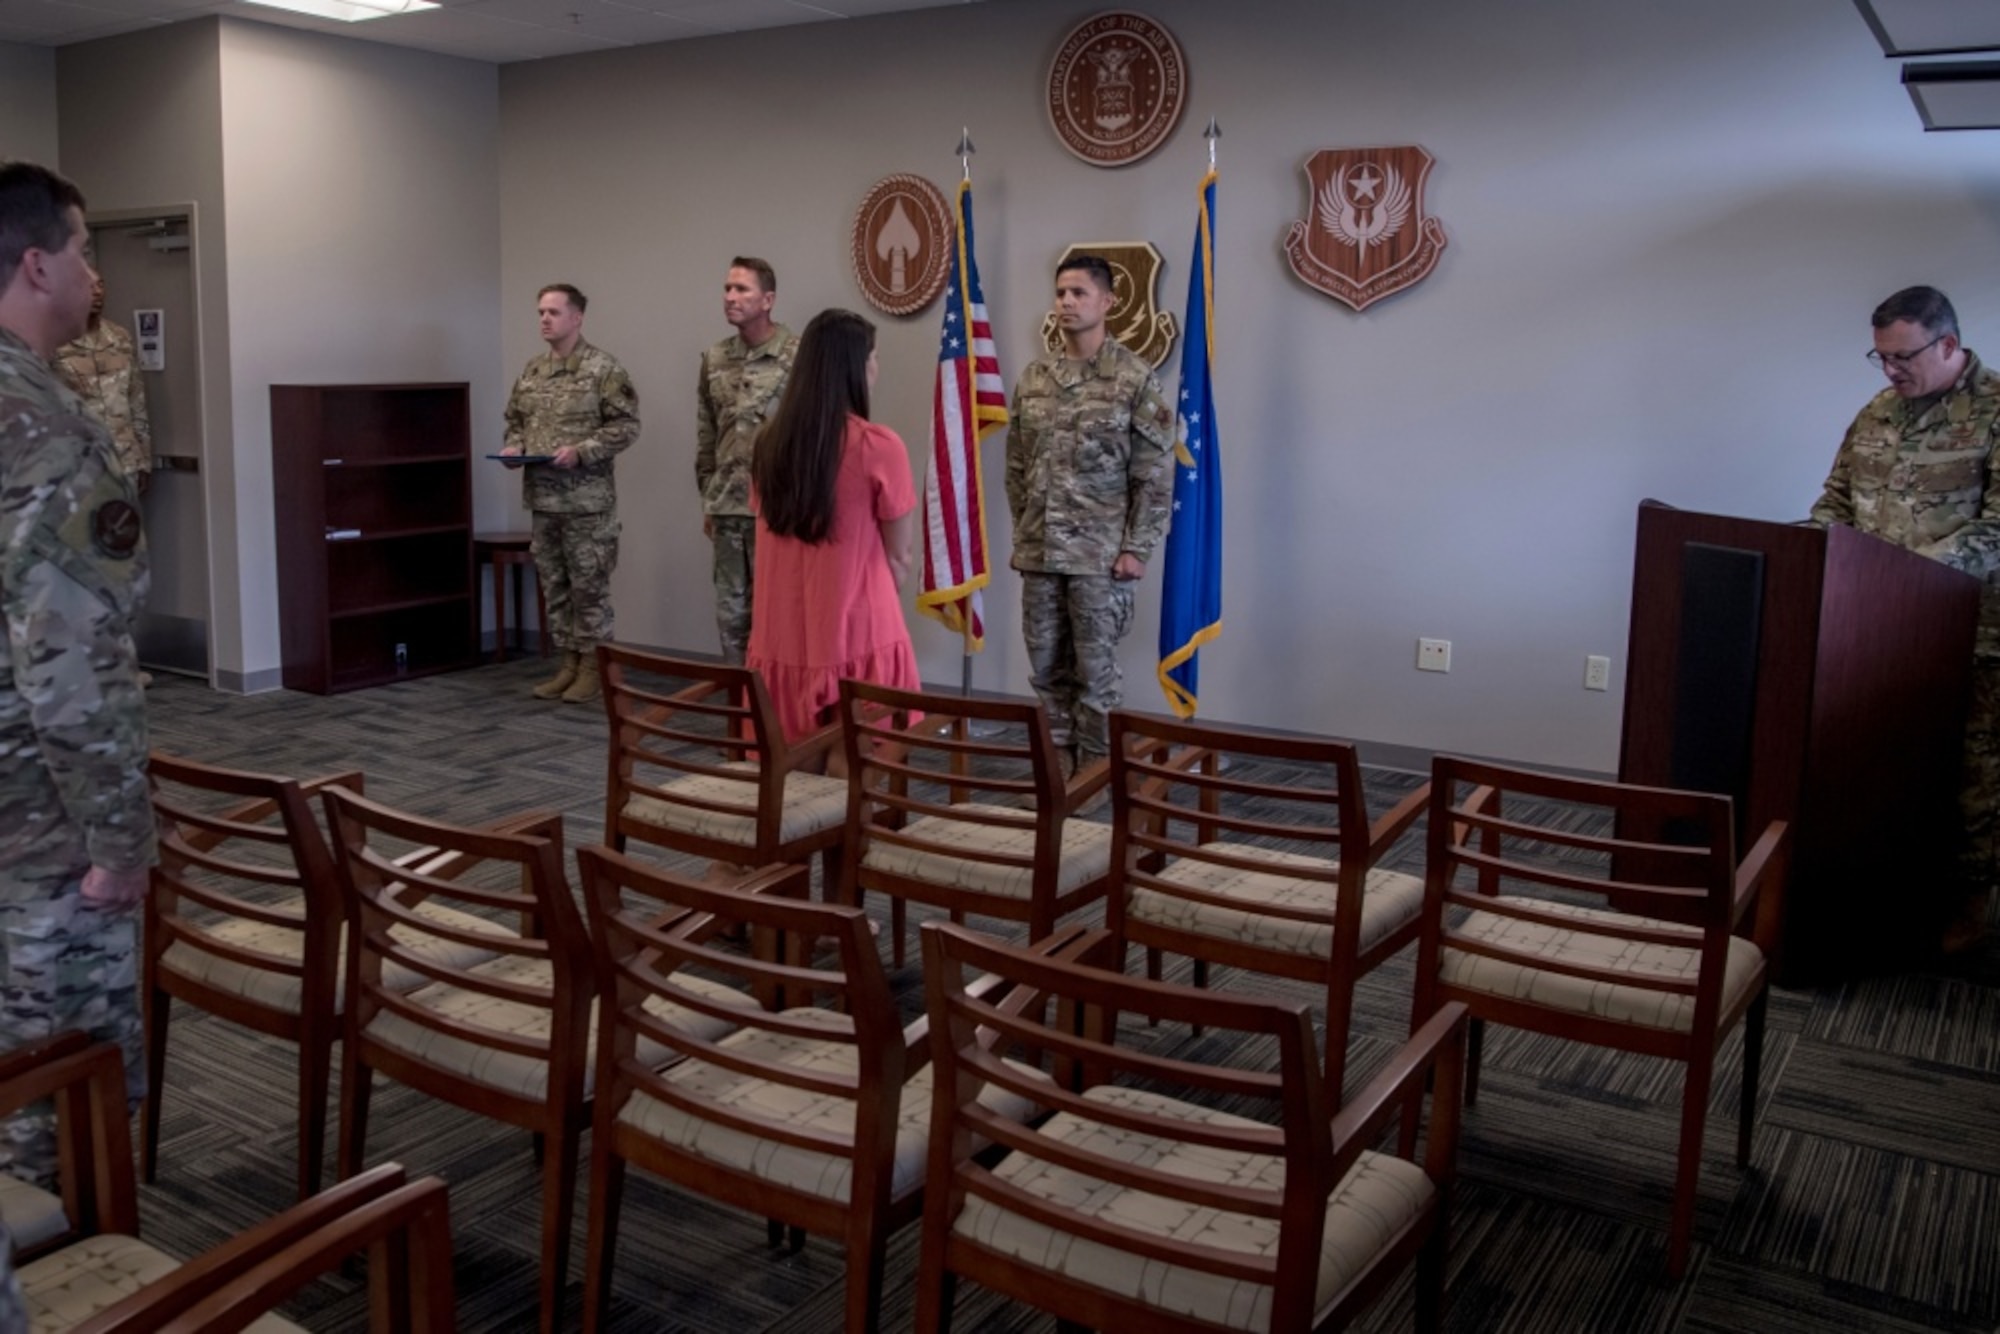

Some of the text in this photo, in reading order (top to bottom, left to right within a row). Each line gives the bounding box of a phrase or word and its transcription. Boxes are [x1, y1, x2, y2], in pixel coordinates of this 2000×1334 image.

[1052, 22, 1096, 105] DEPARTMENT
[1098, 16, 1118, 29] OF
[1120, 16, 1147, 33] THE
[1161, 49, 1178, 96] FORCE
